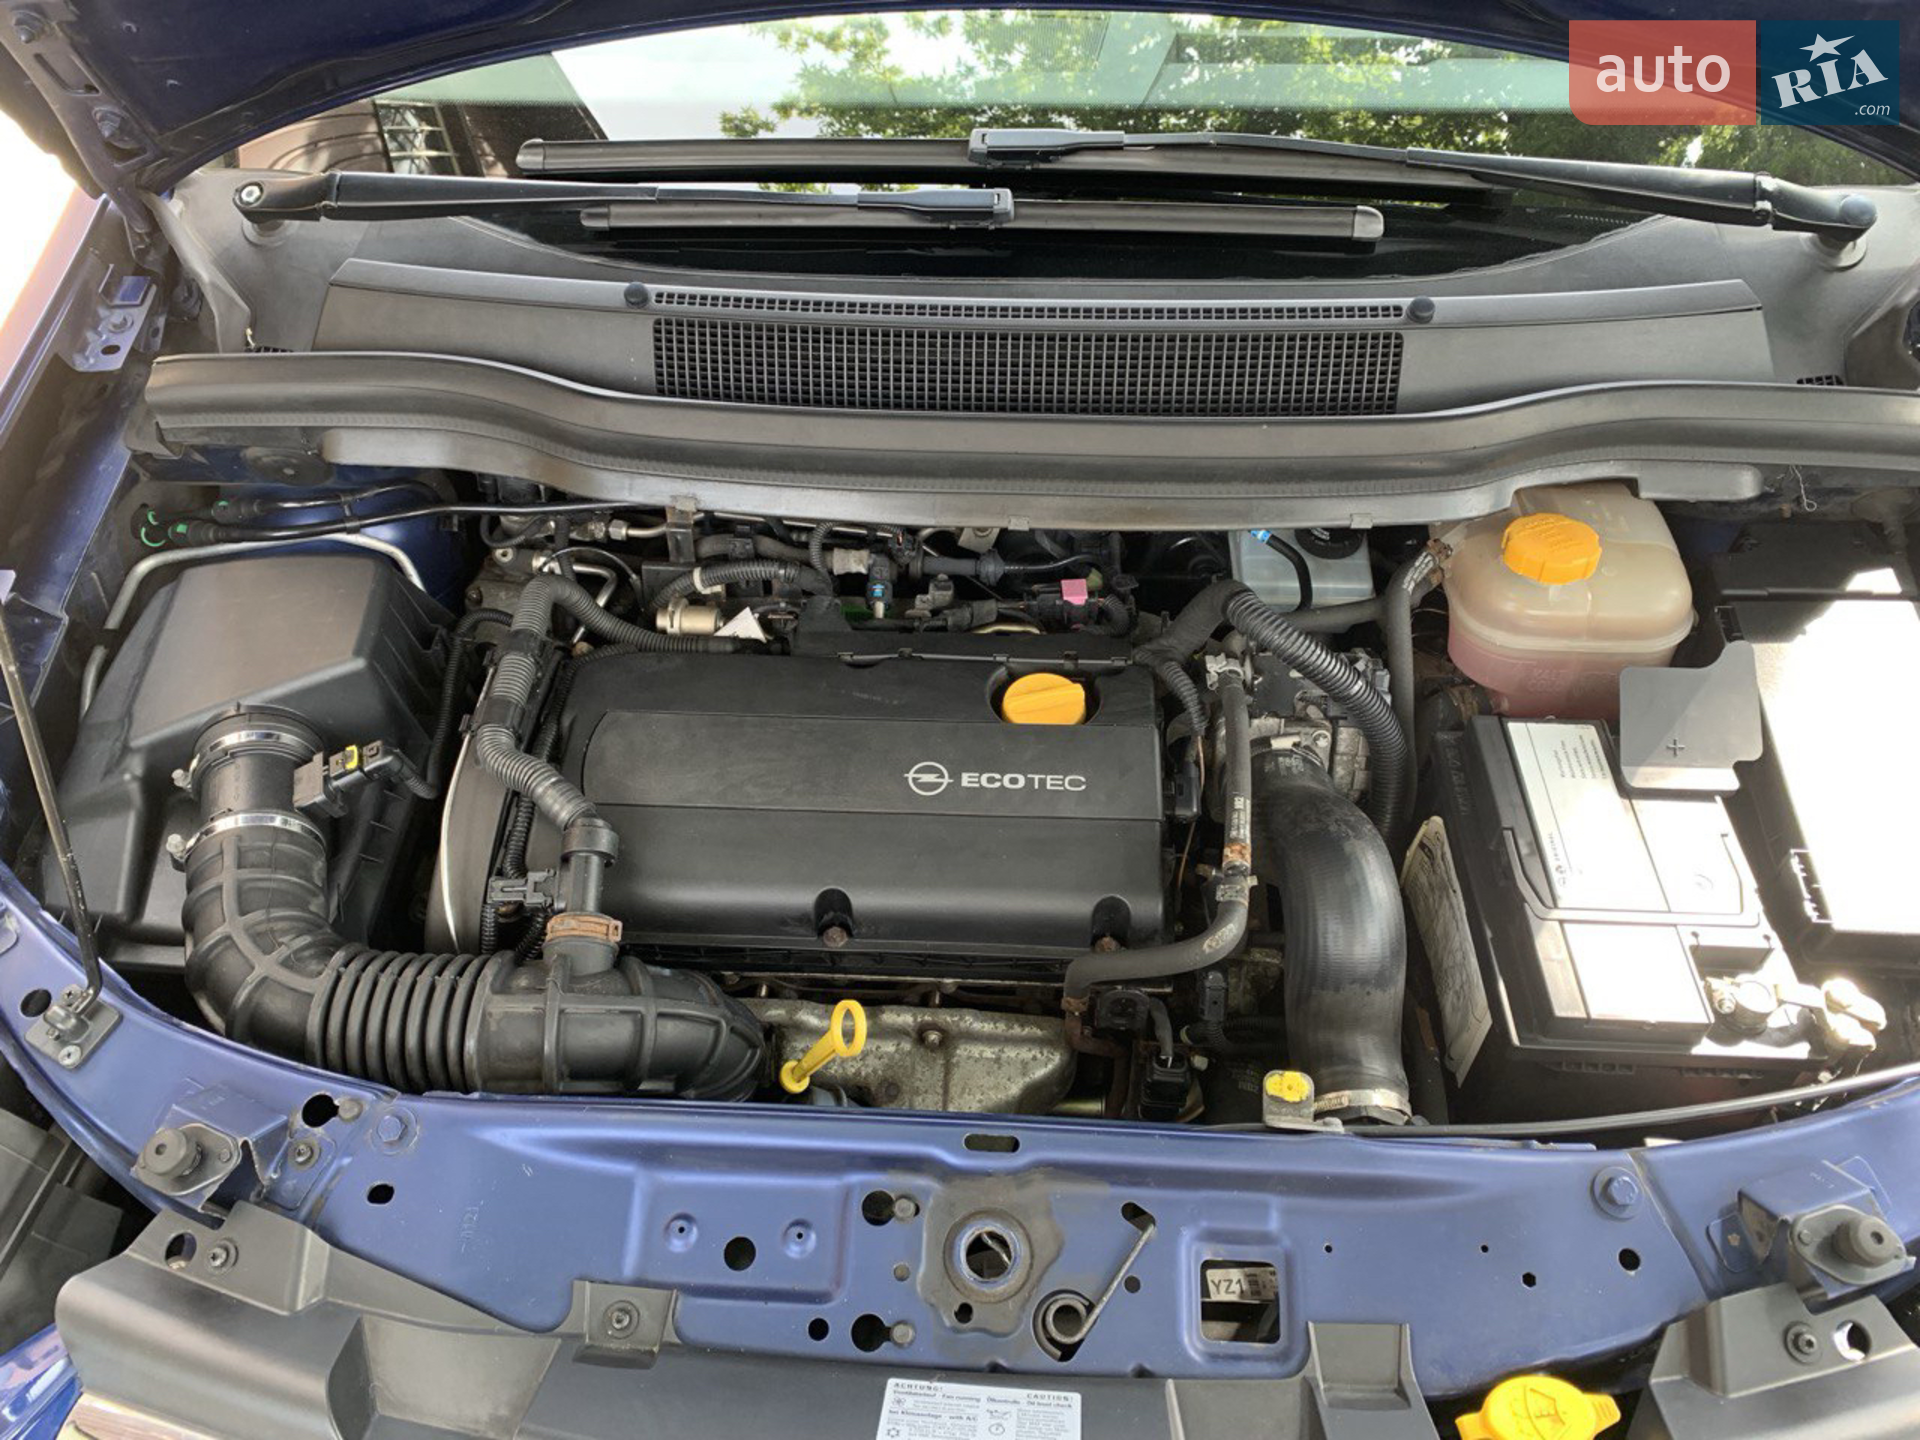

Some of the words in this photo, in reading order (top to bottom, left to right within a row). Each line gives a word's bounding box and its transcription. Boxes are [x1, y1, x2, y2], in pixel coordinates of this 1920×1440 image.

[961, 772, 1087, 791] ECOTEC
[894, 1382, 943, 1392] ACHTUNG!
[1026, 1393, 1073, 1402] CAUTION!
